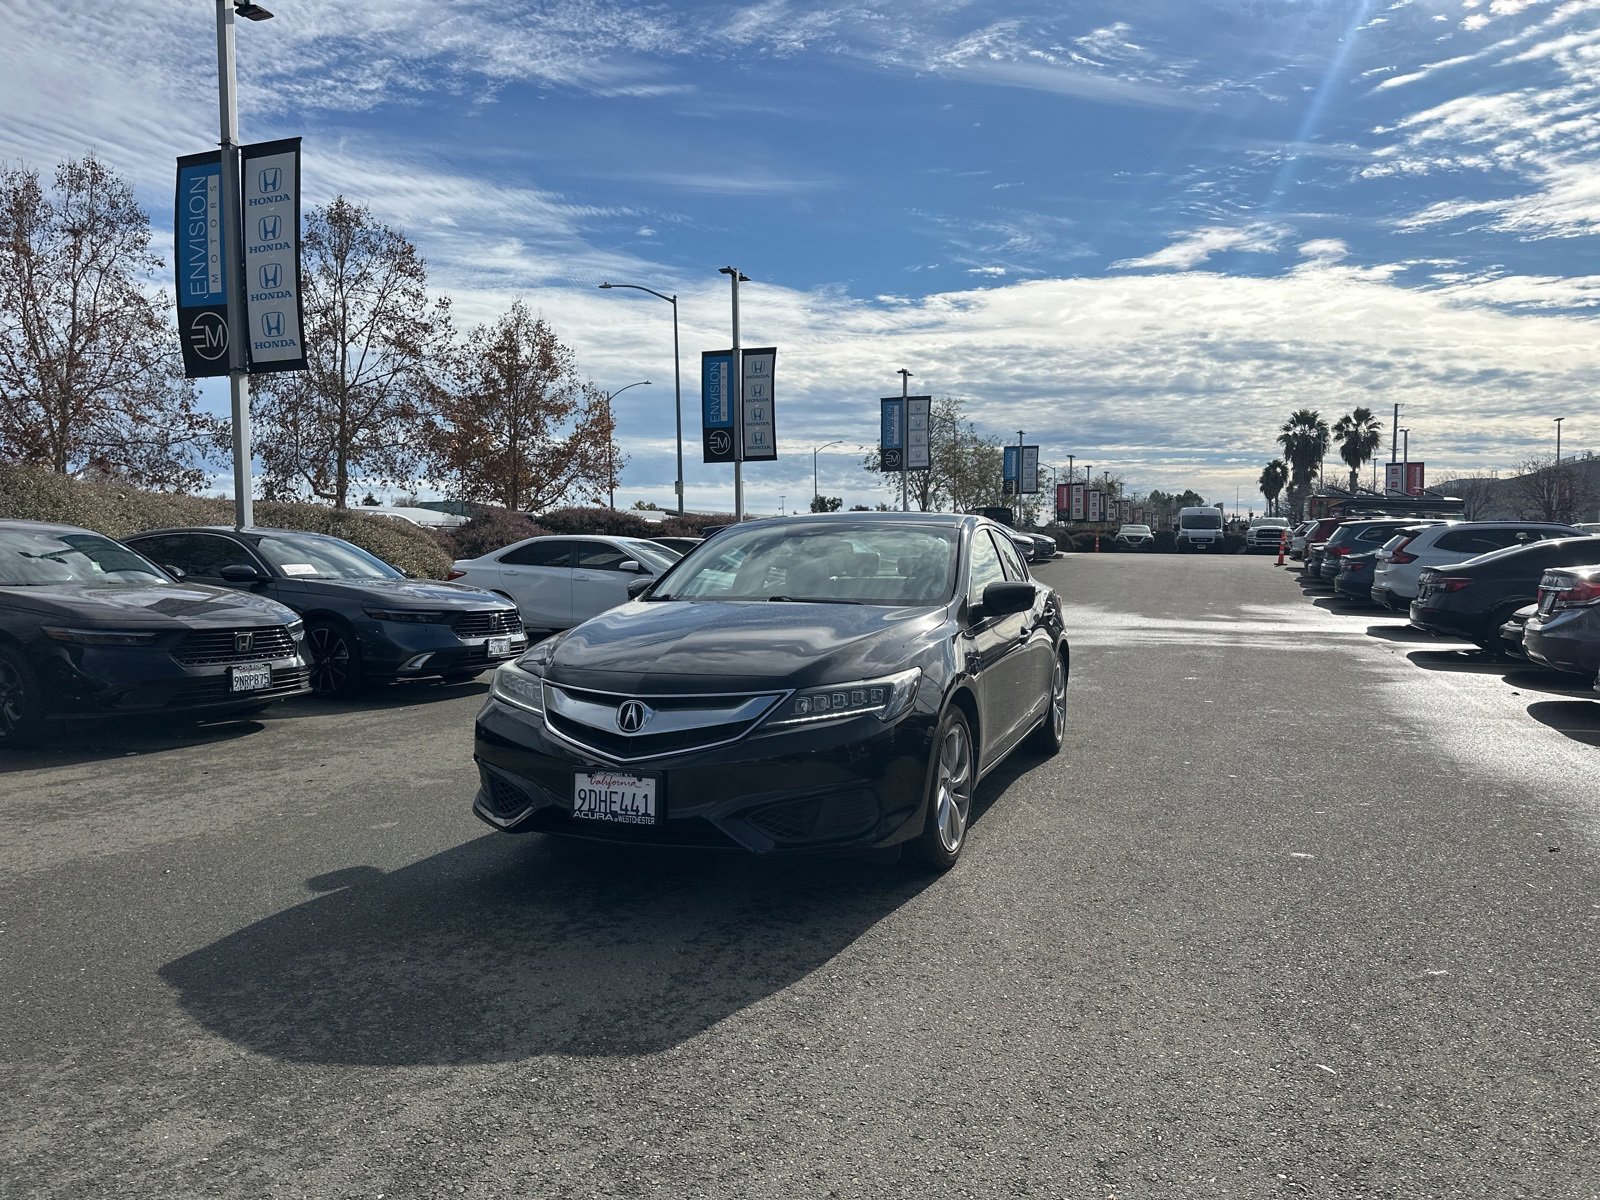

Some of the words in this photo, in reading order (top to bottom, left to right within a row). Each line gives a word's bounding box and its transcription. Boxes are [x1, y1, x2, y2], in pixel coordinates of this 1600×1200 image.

[248, 193, 291, 206] HONDA
[188, 176, 207, 295] ENVISION
[209, 185, 220, 283] MOTORS
[248, 241, 291, 254] HONDA
[250, 289, 293, 302] HONDA
[254, 337, 297, 350] HONDA
[709, 362, 720, 423] ENVISION
[234, 672, 269, 688] 9NRP875
[589, 775, 642, 789] California
[577, 788, 651, 816] 9DHE441
[572, 810, 614, 821] ACURA
[618, 815, 655, 825] WESTCHESTER
